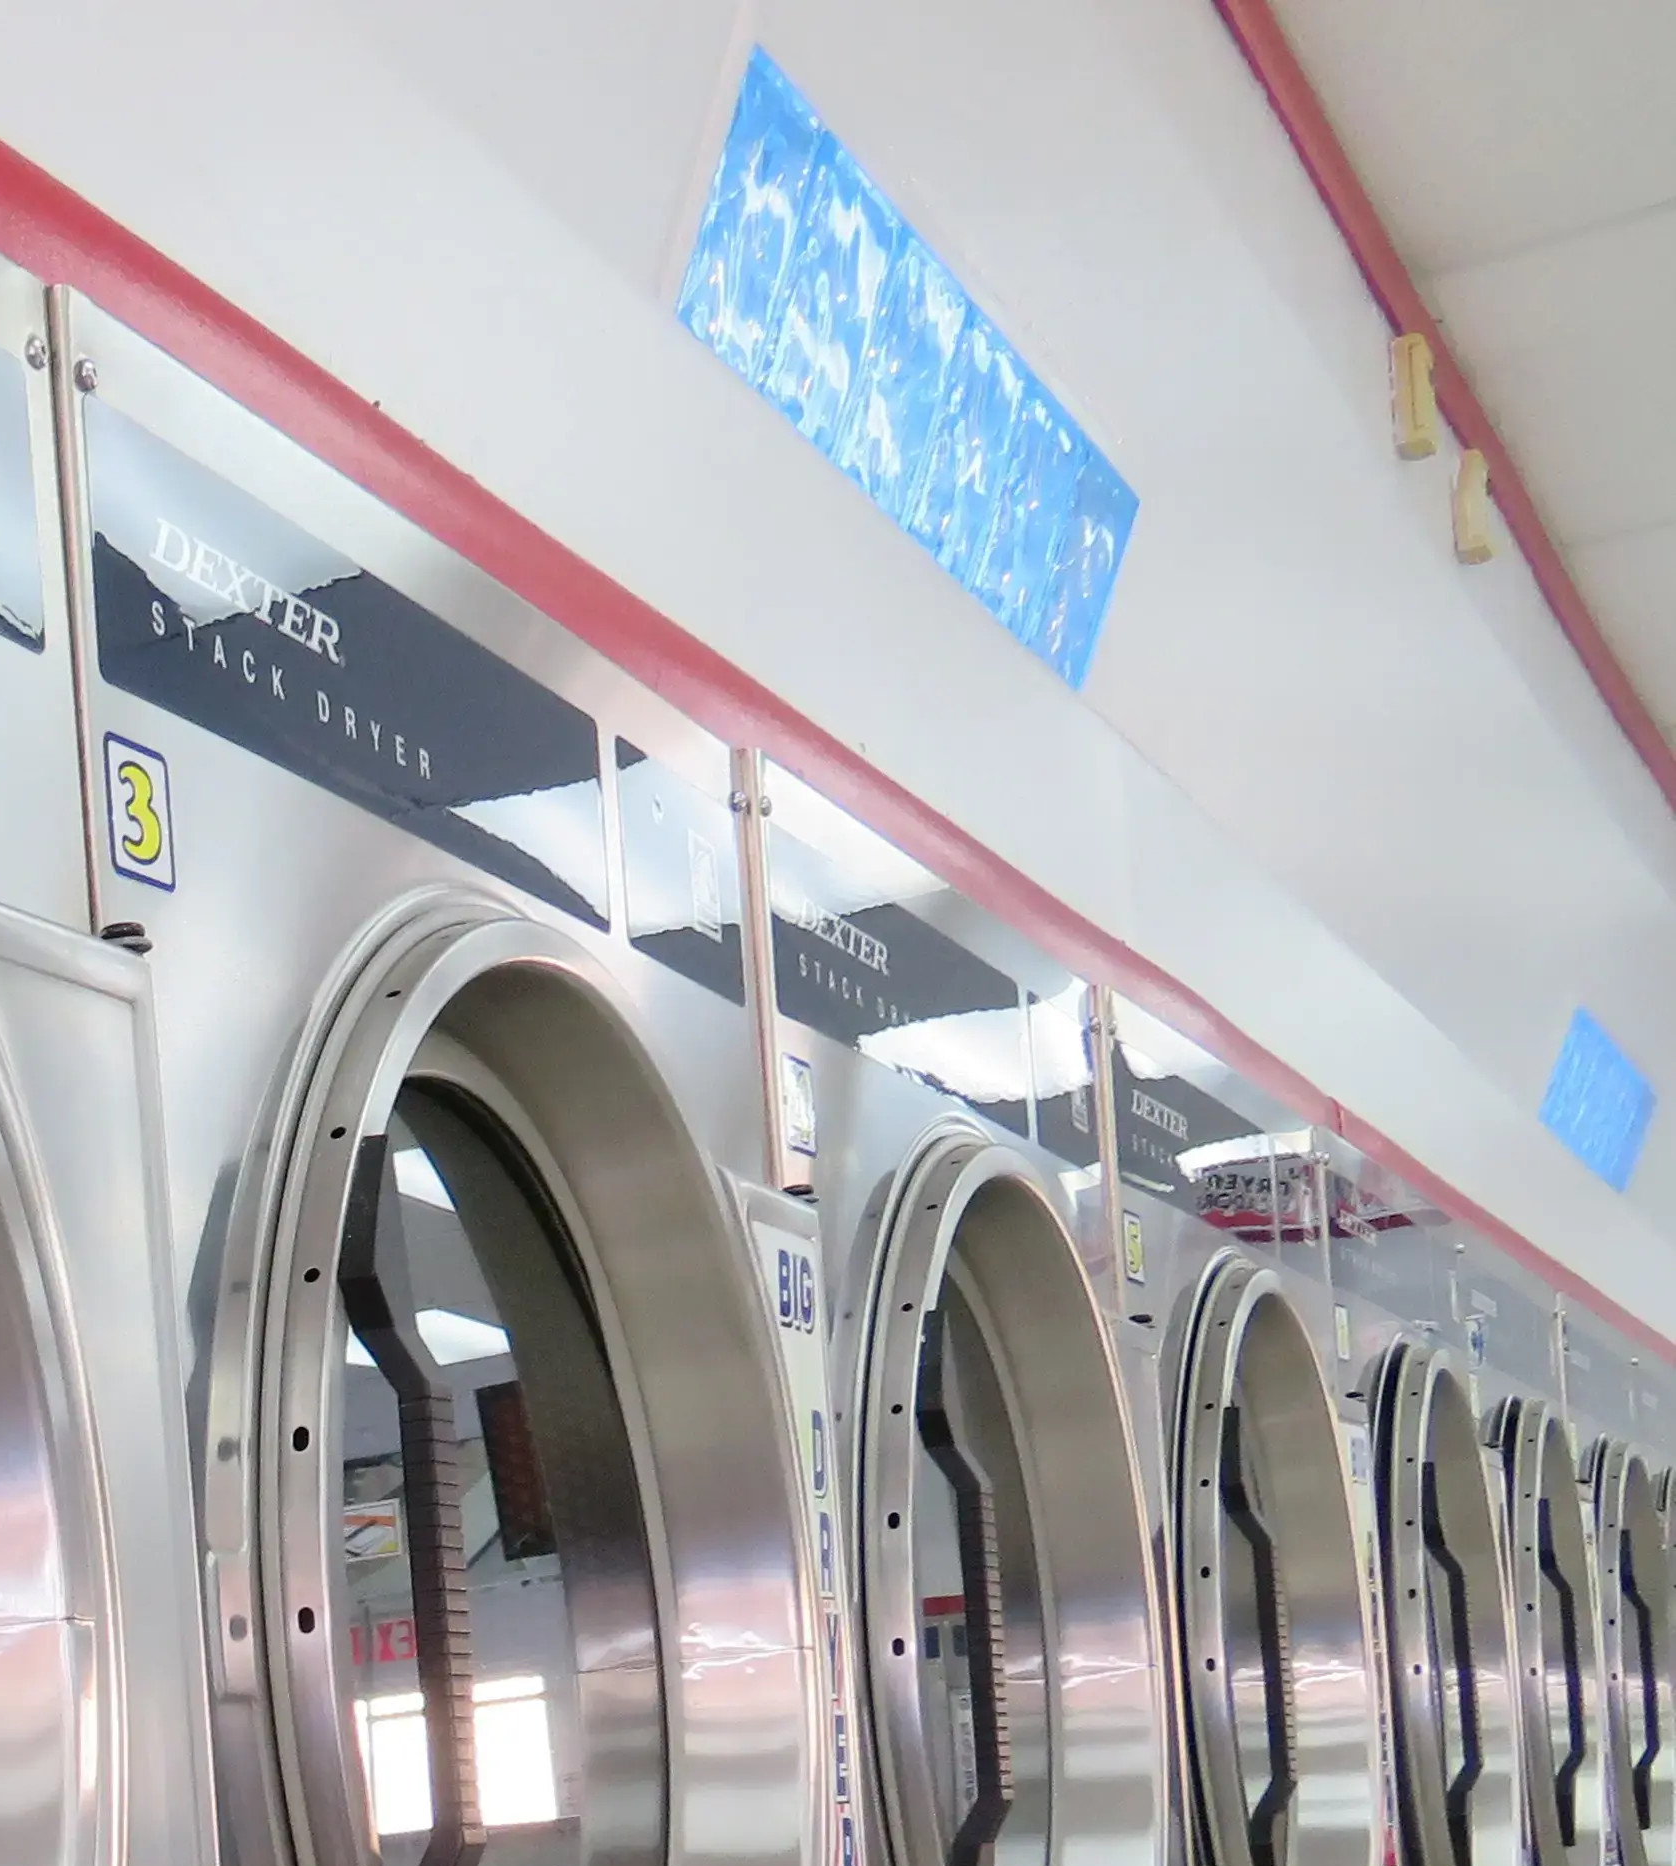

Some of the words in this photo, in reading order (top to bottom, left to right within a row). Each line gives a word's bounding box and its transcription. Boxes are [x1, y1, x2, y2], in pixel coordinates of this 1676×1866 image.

[149, 516, 342, 667] DEXTER
[151, 600, 286, 700] STACK
[316, 689, 432, 781] DRYER
[118, 760, 162, 866] 3
[799, 899, 891, 976] DEXTER
[799, 952, 865, 1009] STACK
[1131, 1088, 1189, 1142] DEXTER
[777, 1248, 815, 1335] BIG
